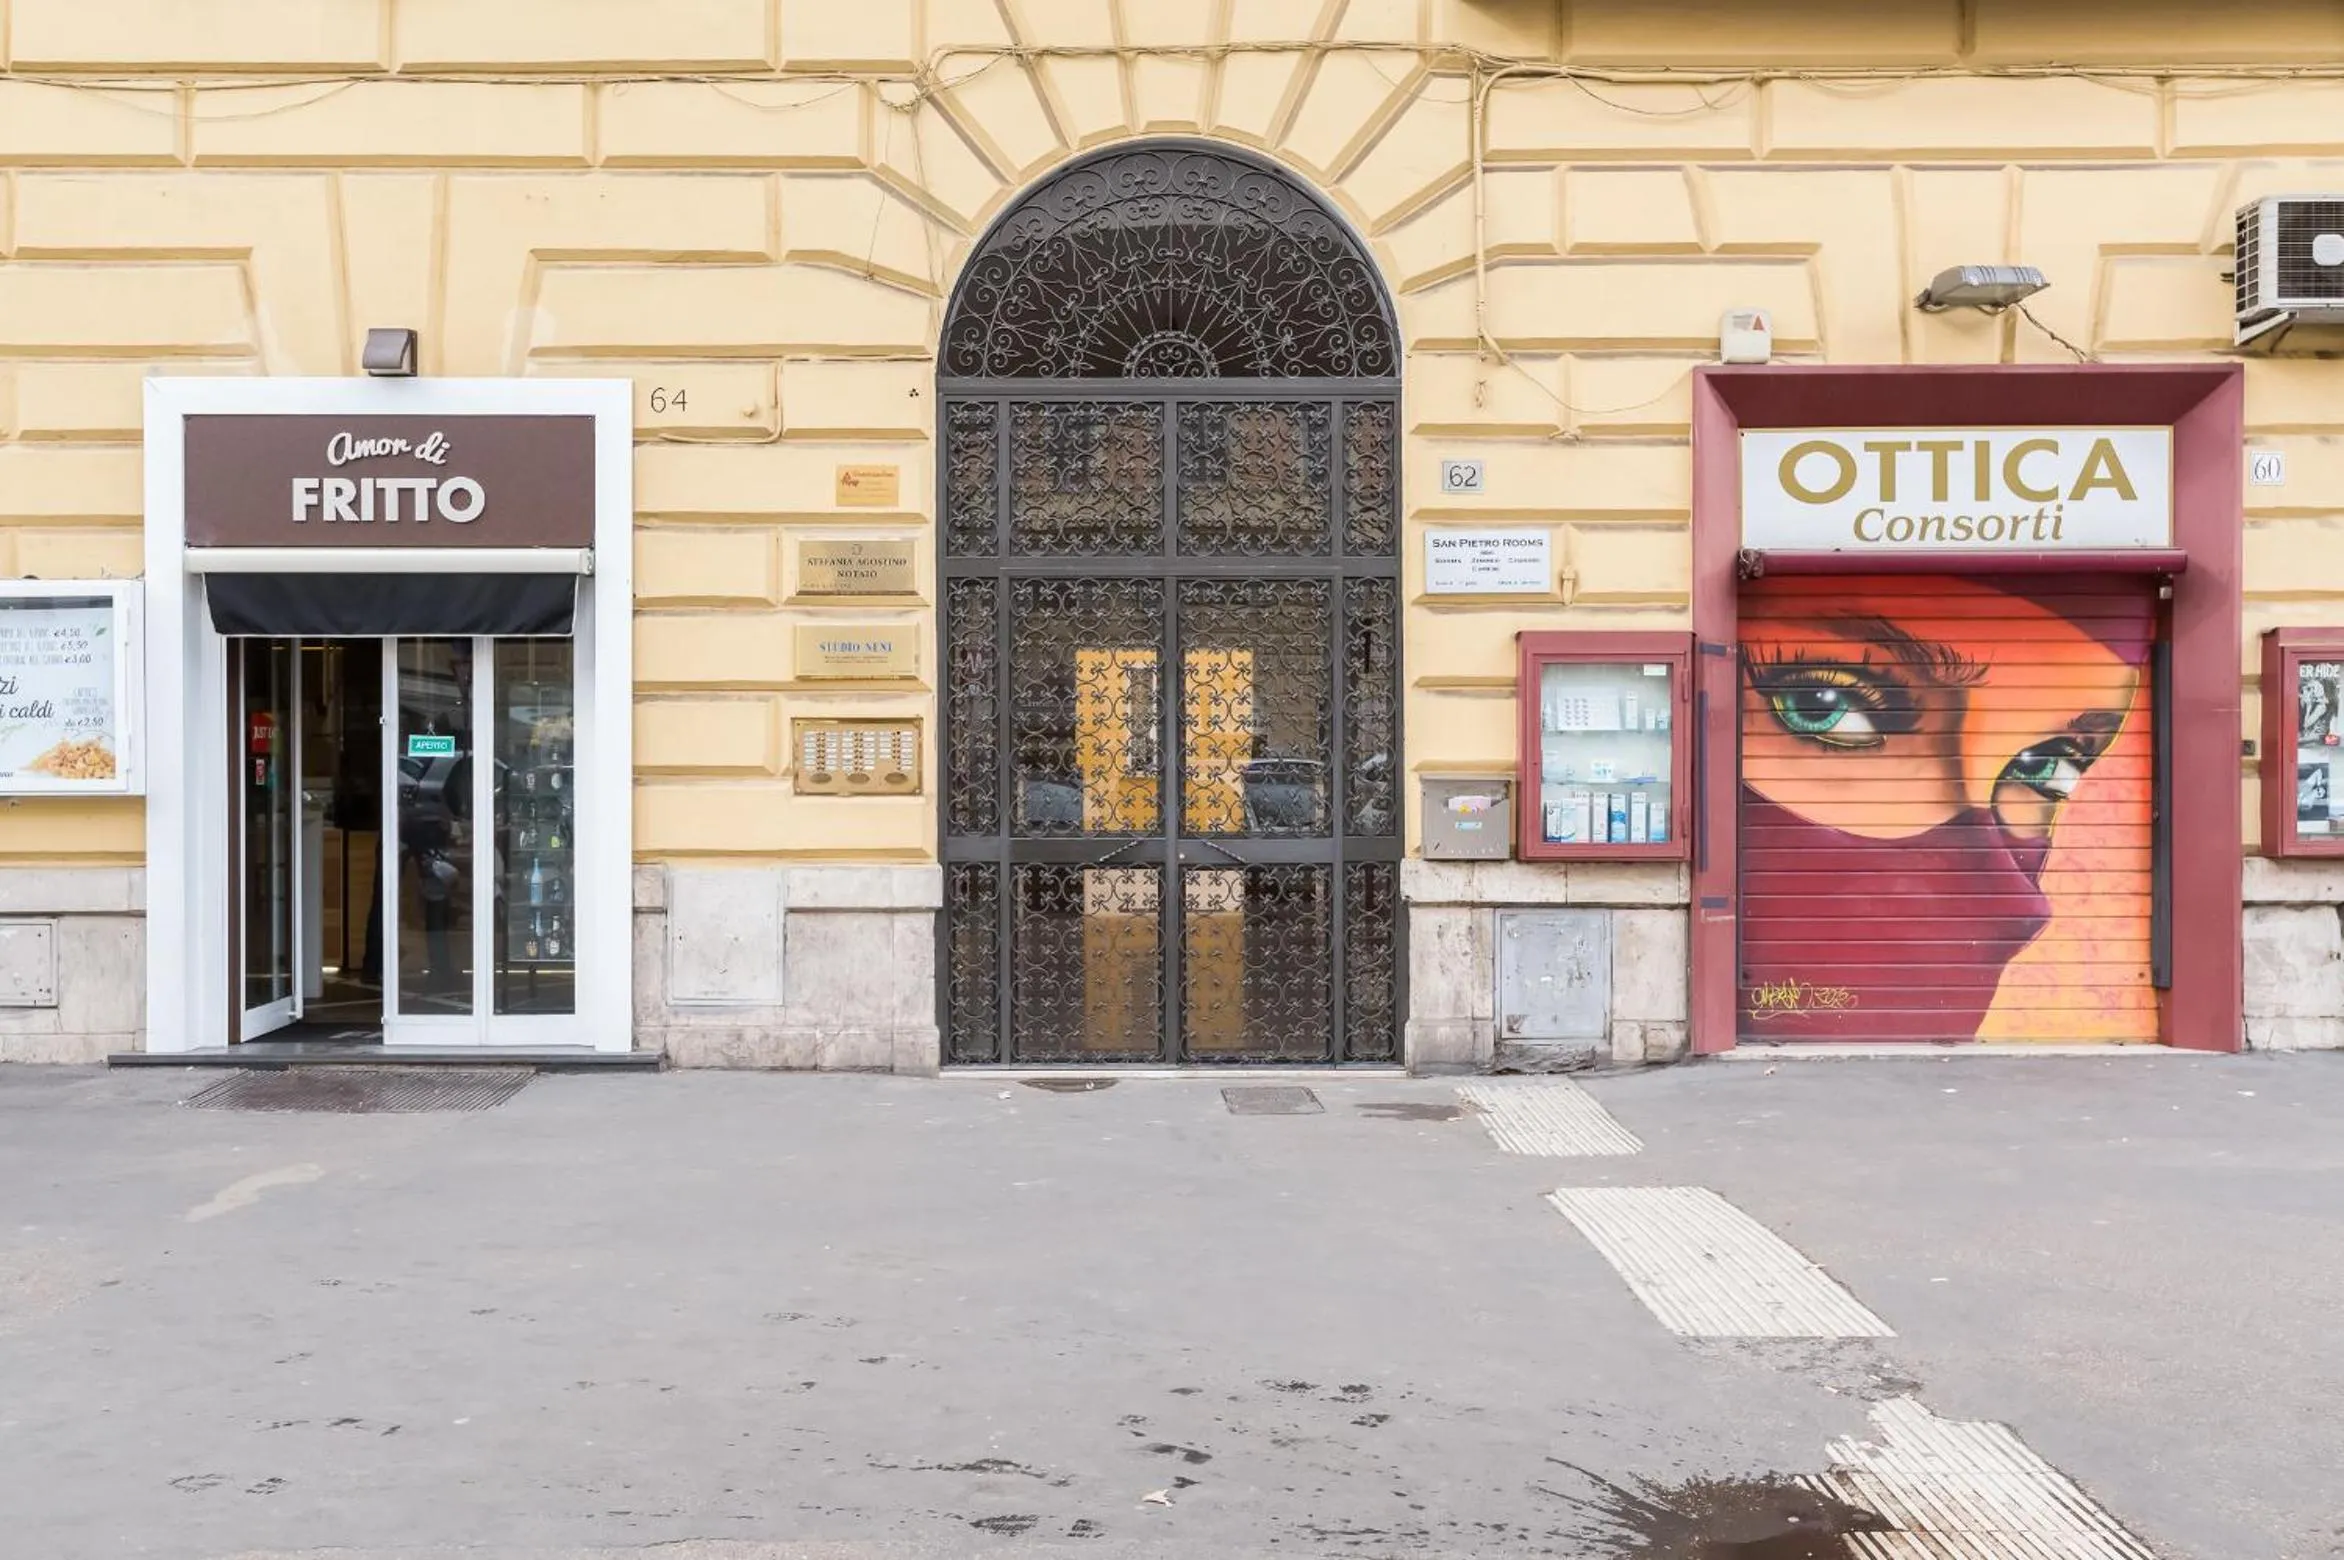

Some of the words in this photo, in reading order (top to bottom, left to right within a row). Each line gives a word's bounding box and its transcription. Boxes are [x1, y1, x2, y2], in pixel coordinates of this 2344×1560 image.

[650, 387, 688, 413] 64
[327, 431, 411, 466] Amor
[415, 431, 450, 465] di
[1449, 465, 1478, 487] 62
[1778, 437, 2138, 505] OTTICA
[2254, 456, 2281, 482] 60
[291, 475, 486, 522] FRITTO
[1853, 505, 2064, 542] Consorti
[1432, 538, 1457, 548] SAN
[1459, 538, 1500, 548] PIETRO
[1502, 538, 1543, 547] ROOMS
[837, 570, 878, 578] NOTAIO
[857, 558, 907, 567] AGOSTINO
[9, 700, 53, 718] caldi
[415, 741, 448, 750] APERTO
